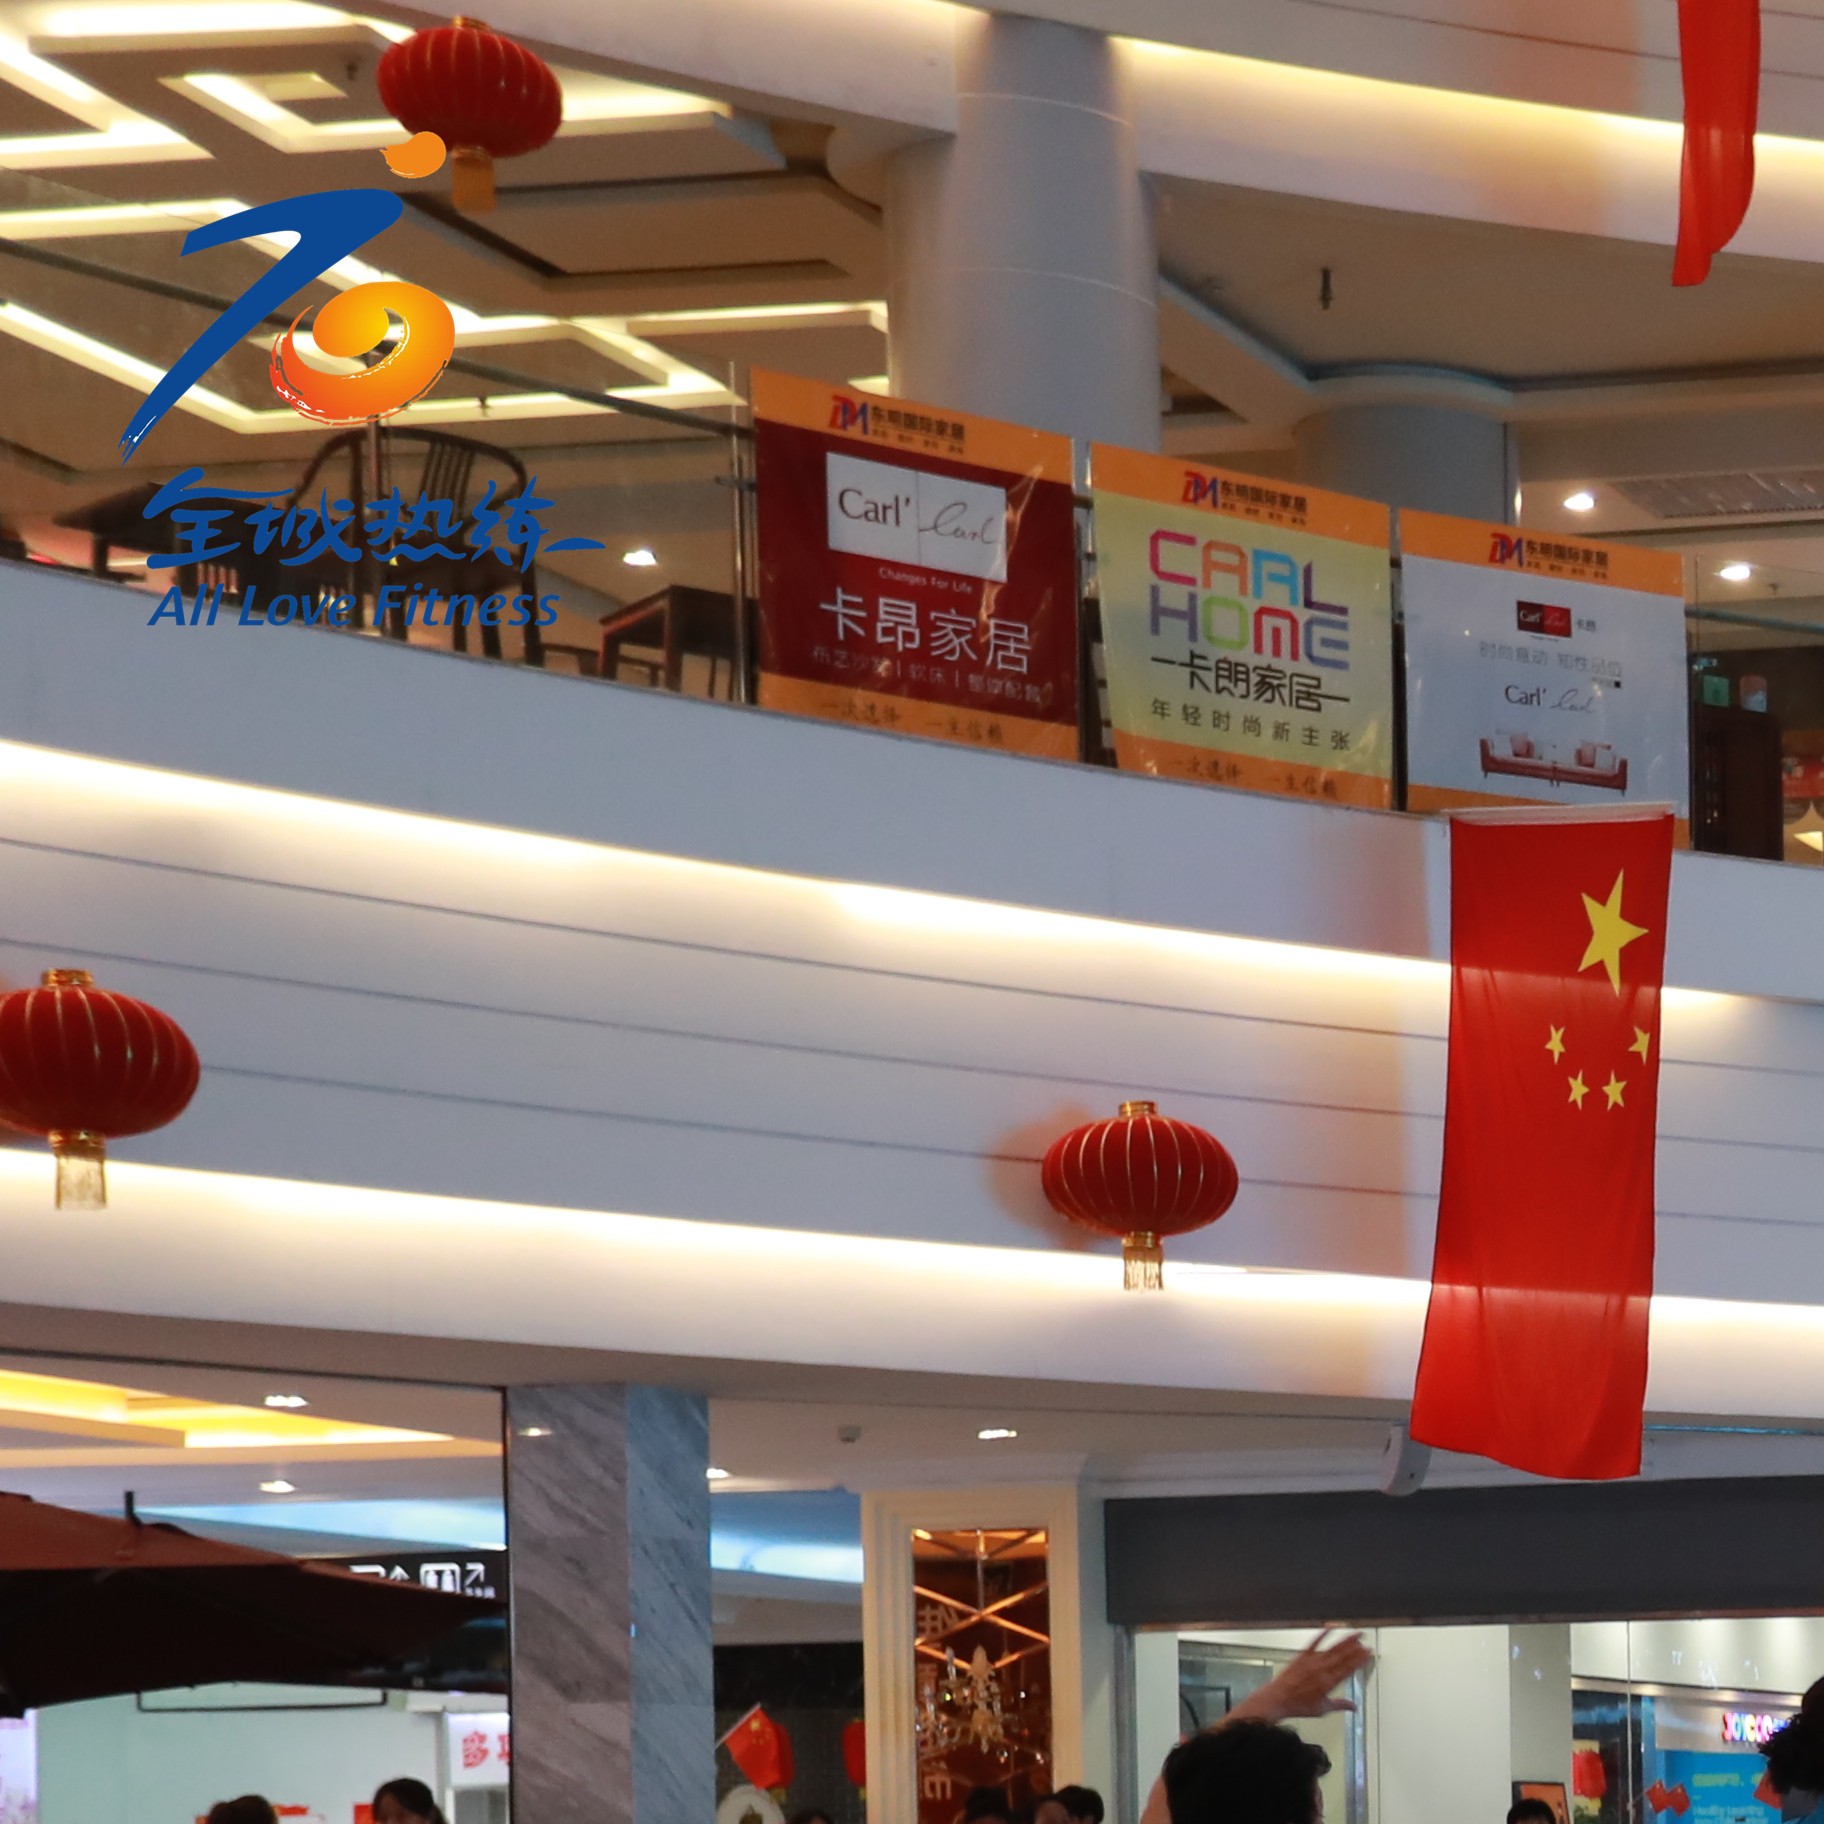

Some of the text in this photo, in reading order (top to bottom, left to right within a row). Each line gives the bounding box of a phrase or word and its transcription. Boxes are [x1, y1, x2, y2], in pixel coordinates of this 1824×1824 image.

[1149, 529, 1348, 616] CARL
[819, 586, 1032, 675] 卡昂家居
[1150, 585, 1349, 671] HOME
[1152, 699, 1350, 751] 年轻时尚新主张
